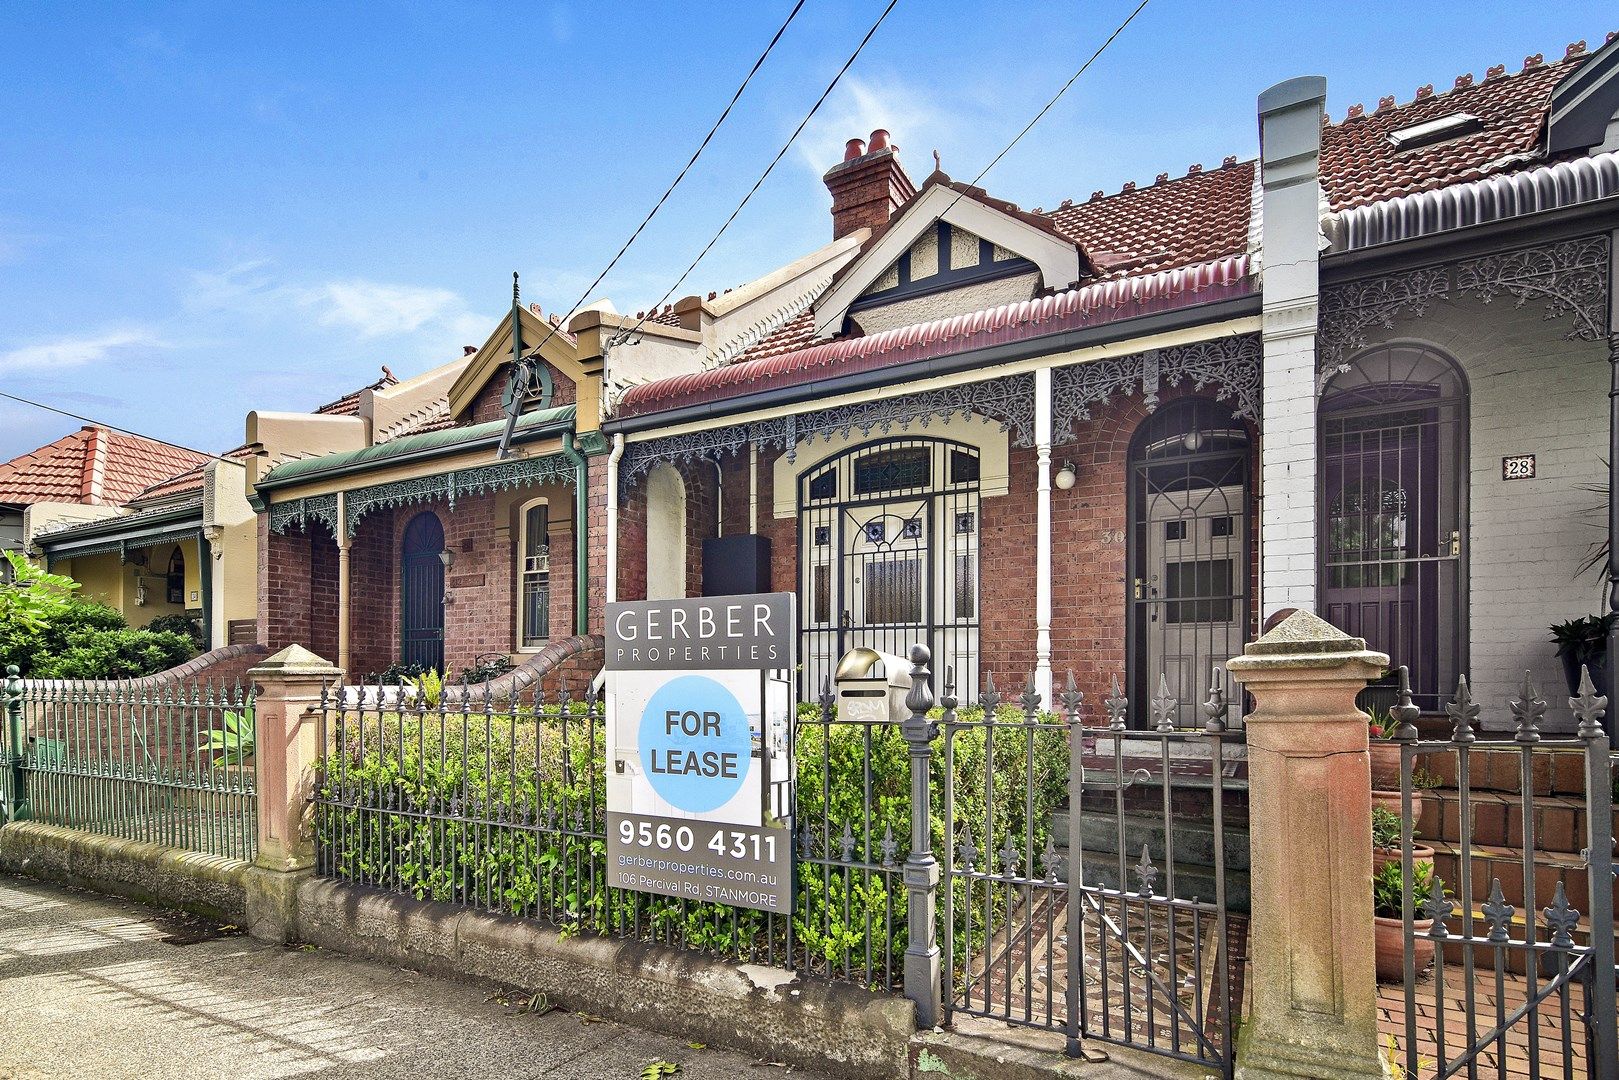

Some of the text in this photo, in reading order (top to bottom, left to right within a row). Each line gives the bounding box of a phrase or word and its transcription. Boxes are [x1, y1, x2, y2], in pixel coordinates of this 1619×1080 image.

[1509, 460, 1529, 474] 28
[1101, 530, 1125, 544] 30
[615, 604, 775, 641] GERBER
[617, 644, 777, 661] PROPERTIES
[665, 710, 721, 737] FOR
[651, 749, 738, 778] LEASE
[619, 820, 777, 863] 9560 4311
[618, 853, 777, 886] gerberproperties.com.au
[618, 872, 777, 907] 106 Percival Rd, STANMORE
